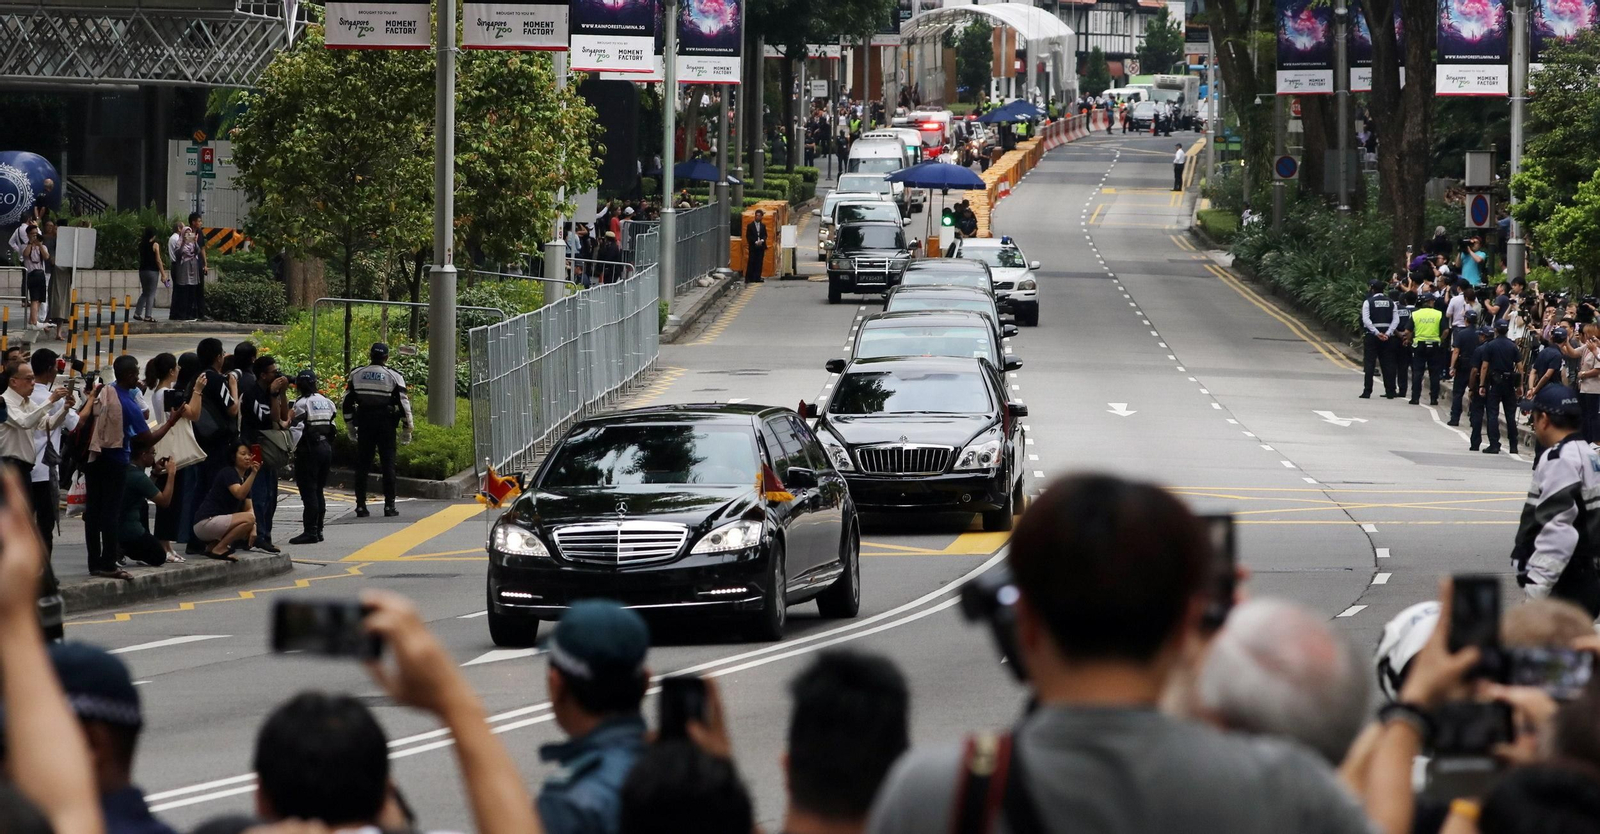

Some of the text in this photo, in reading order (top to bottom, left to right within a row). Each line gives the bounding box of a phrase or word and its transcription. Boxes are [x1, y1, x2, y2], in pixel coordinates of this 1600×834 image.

[339, 17, 369, 31] Singapore
[476, 18, 507, 31] Singapore
[357, 26, 375, 38] Zoo
[495, 27, 512, 39] Zoo
[582, 46, 606, 57] Singapore
[596, 54, 610, 63] Zoo
[202, 180, 207, 190] 2
[362, 372, 386, 381] POLICE
